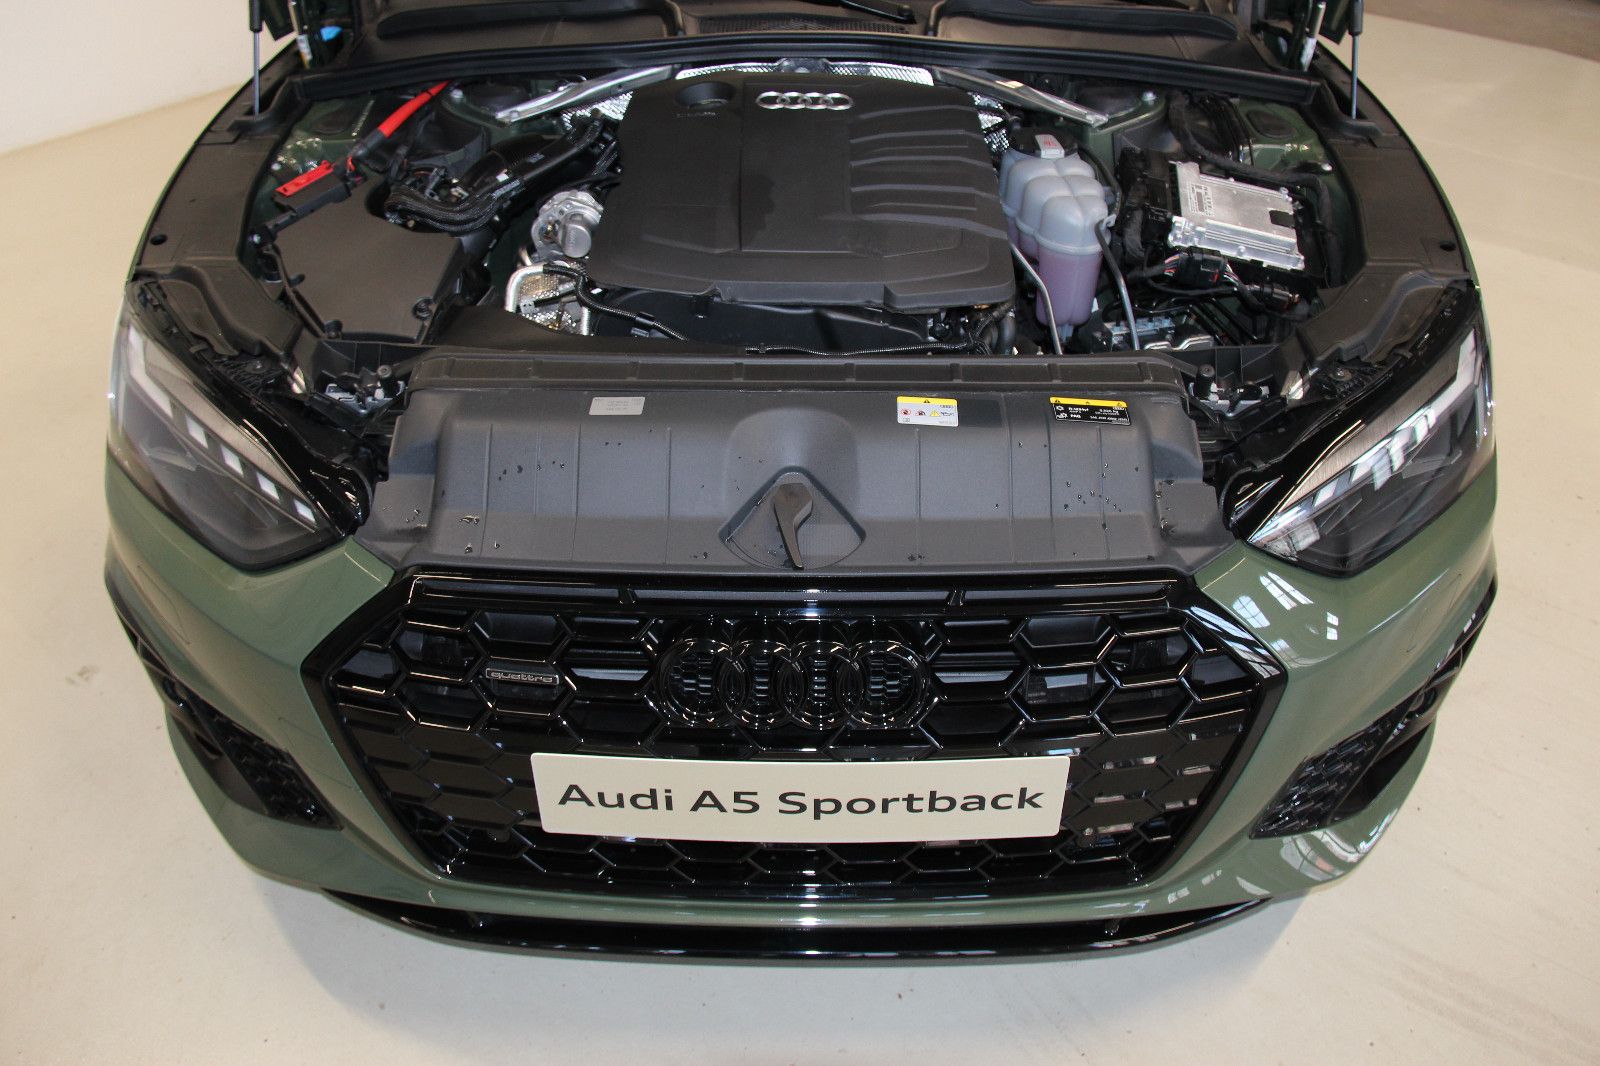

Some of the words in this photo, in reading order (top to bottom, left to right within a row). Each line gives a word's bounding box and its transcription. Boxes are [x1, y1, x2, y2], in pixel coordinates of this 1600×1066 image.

[490, 672, 553, 683] quattro
[558, 784, 674, 811] Audi
[690, 790, 760, 814] A5
[778, 787, 1044, 821] Sportback
